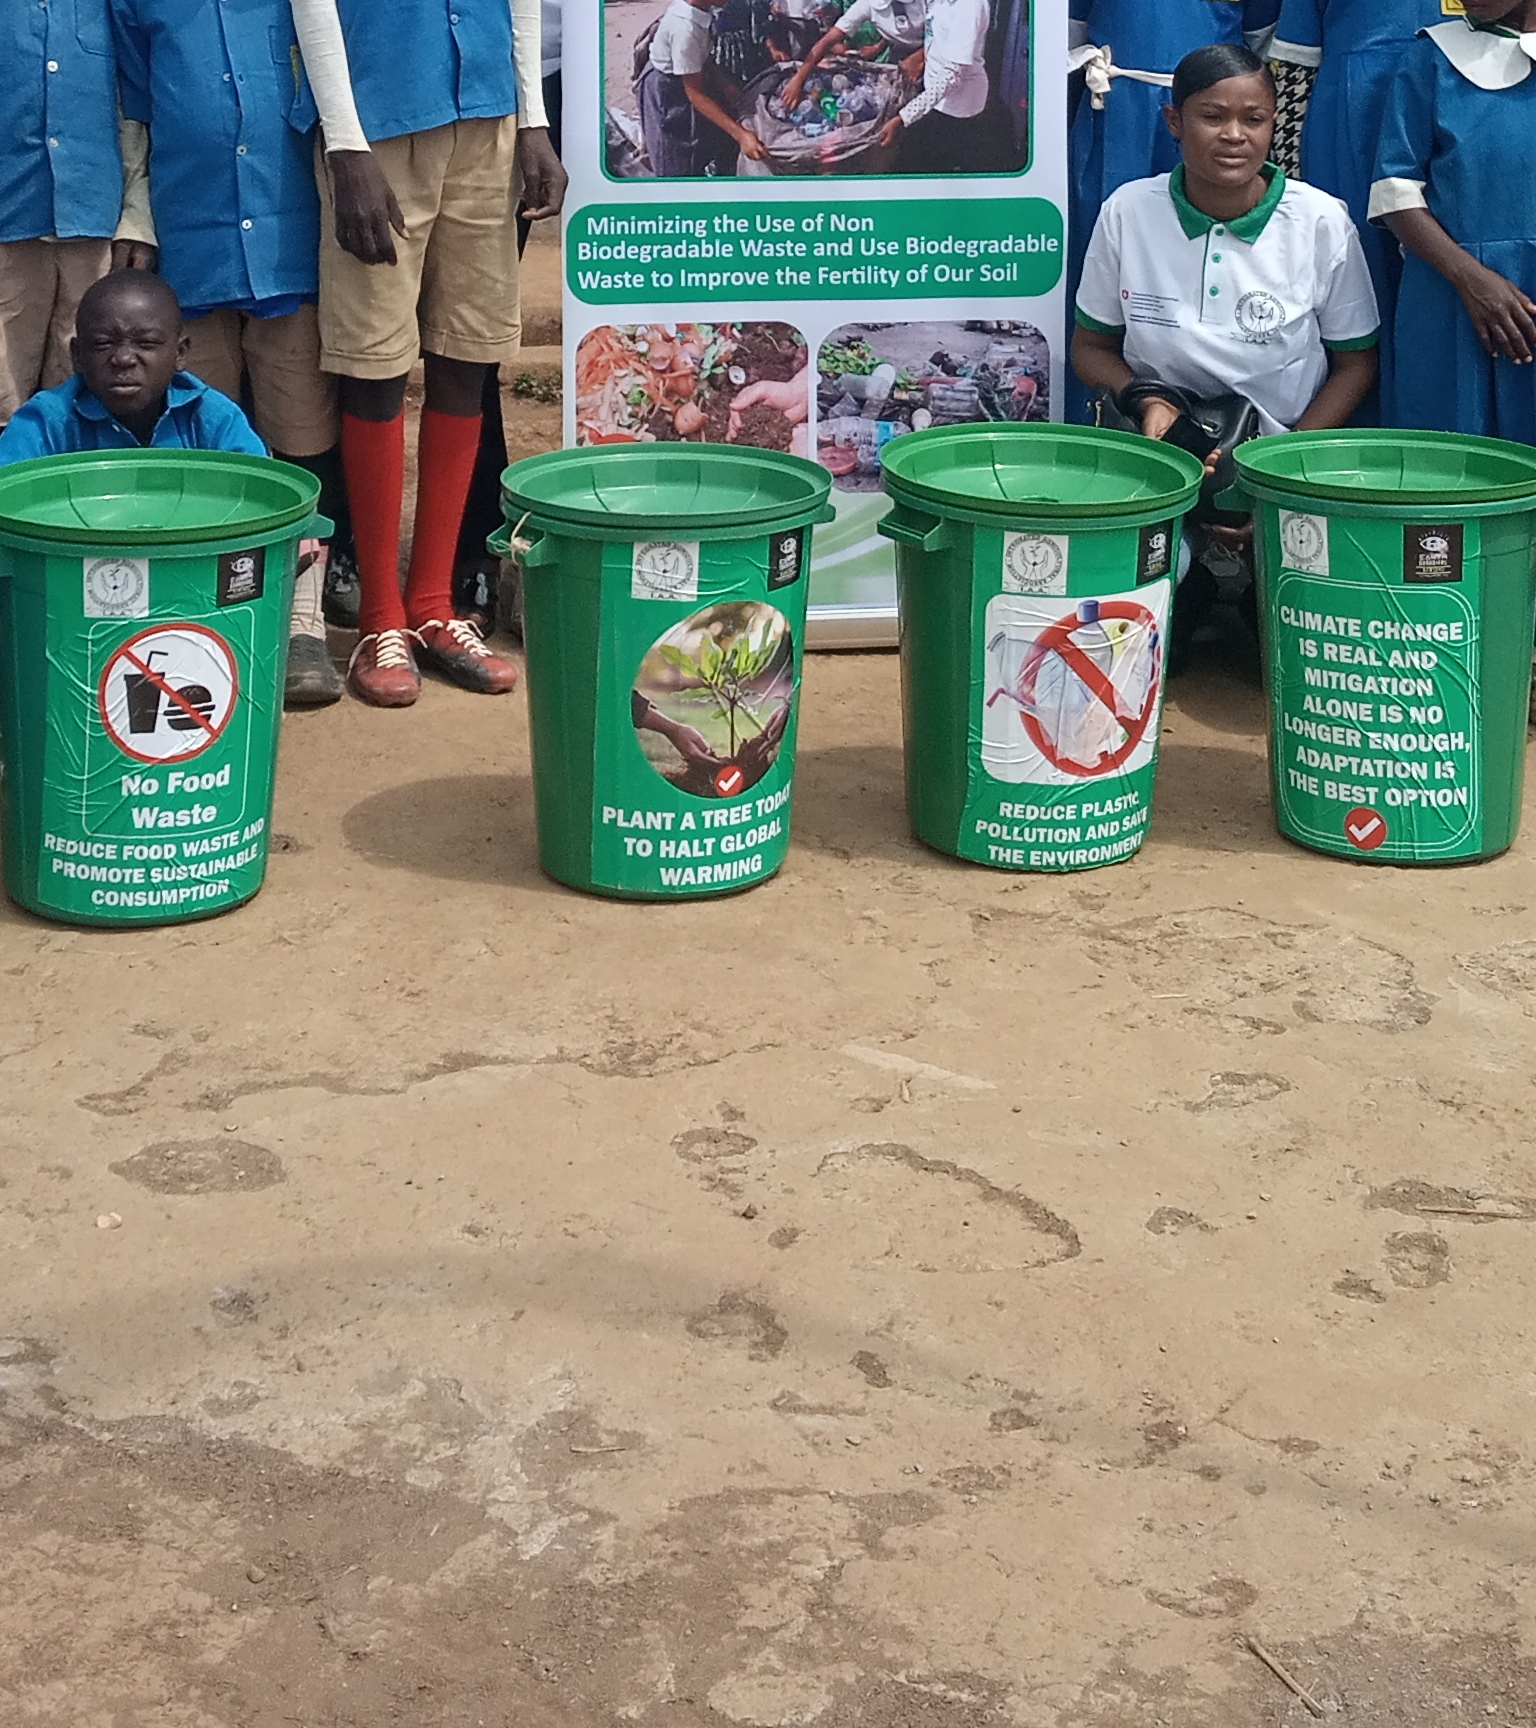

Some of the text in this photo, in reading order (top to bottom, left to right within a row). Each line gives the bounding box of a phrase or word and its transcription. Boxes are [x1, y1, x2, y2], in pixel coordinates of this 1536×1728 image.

[587, 213, 874, 237] Minimizing the Use of Non
[578, 234, 1059, 263] Biodegradable Waste and Use Biodegradable
[578, 263, 1018, 290] Waste to Improve the Fertility of Our Soil
[1280, 606, 1463, 641] CLIMATE CHANGE
[1299, 638, 1438, 669] IS REAL AND
[1305, 667, 1434, 696] MITIGATION
[1303, 694, 1443, 724] ALONE IS NO
[1284, 712, 1470, 753] LONGER ENOUGH,
[1296, 745, 1455, 780] ADAPTATION IS
[121, 764, 231, 796] No Food
[1288, 768, 1467, 807] THE BEST OPTION
[131, 803, 217, 829] Waste
[602, 779, 791, 830] PLANT A TREE TODAY
[999, 791, 1139, 820] REDUCE PLASTIC
[44, 817, 264, 860] REDUCE FOOD WASTE AND
[624, 817, 782, 858] TO HALT GLOBAL
[975, 806, 1148, 843] POLLUTION AND SAVE
[52, 843, 258, 884] PROMOTE SUSTAINABLE
[988, 830, 1145, 866] THE ENVIRONMENT
[660, 854, 762, 886] WARMING
[91, 879, 230, 907] CONSUMPTION
